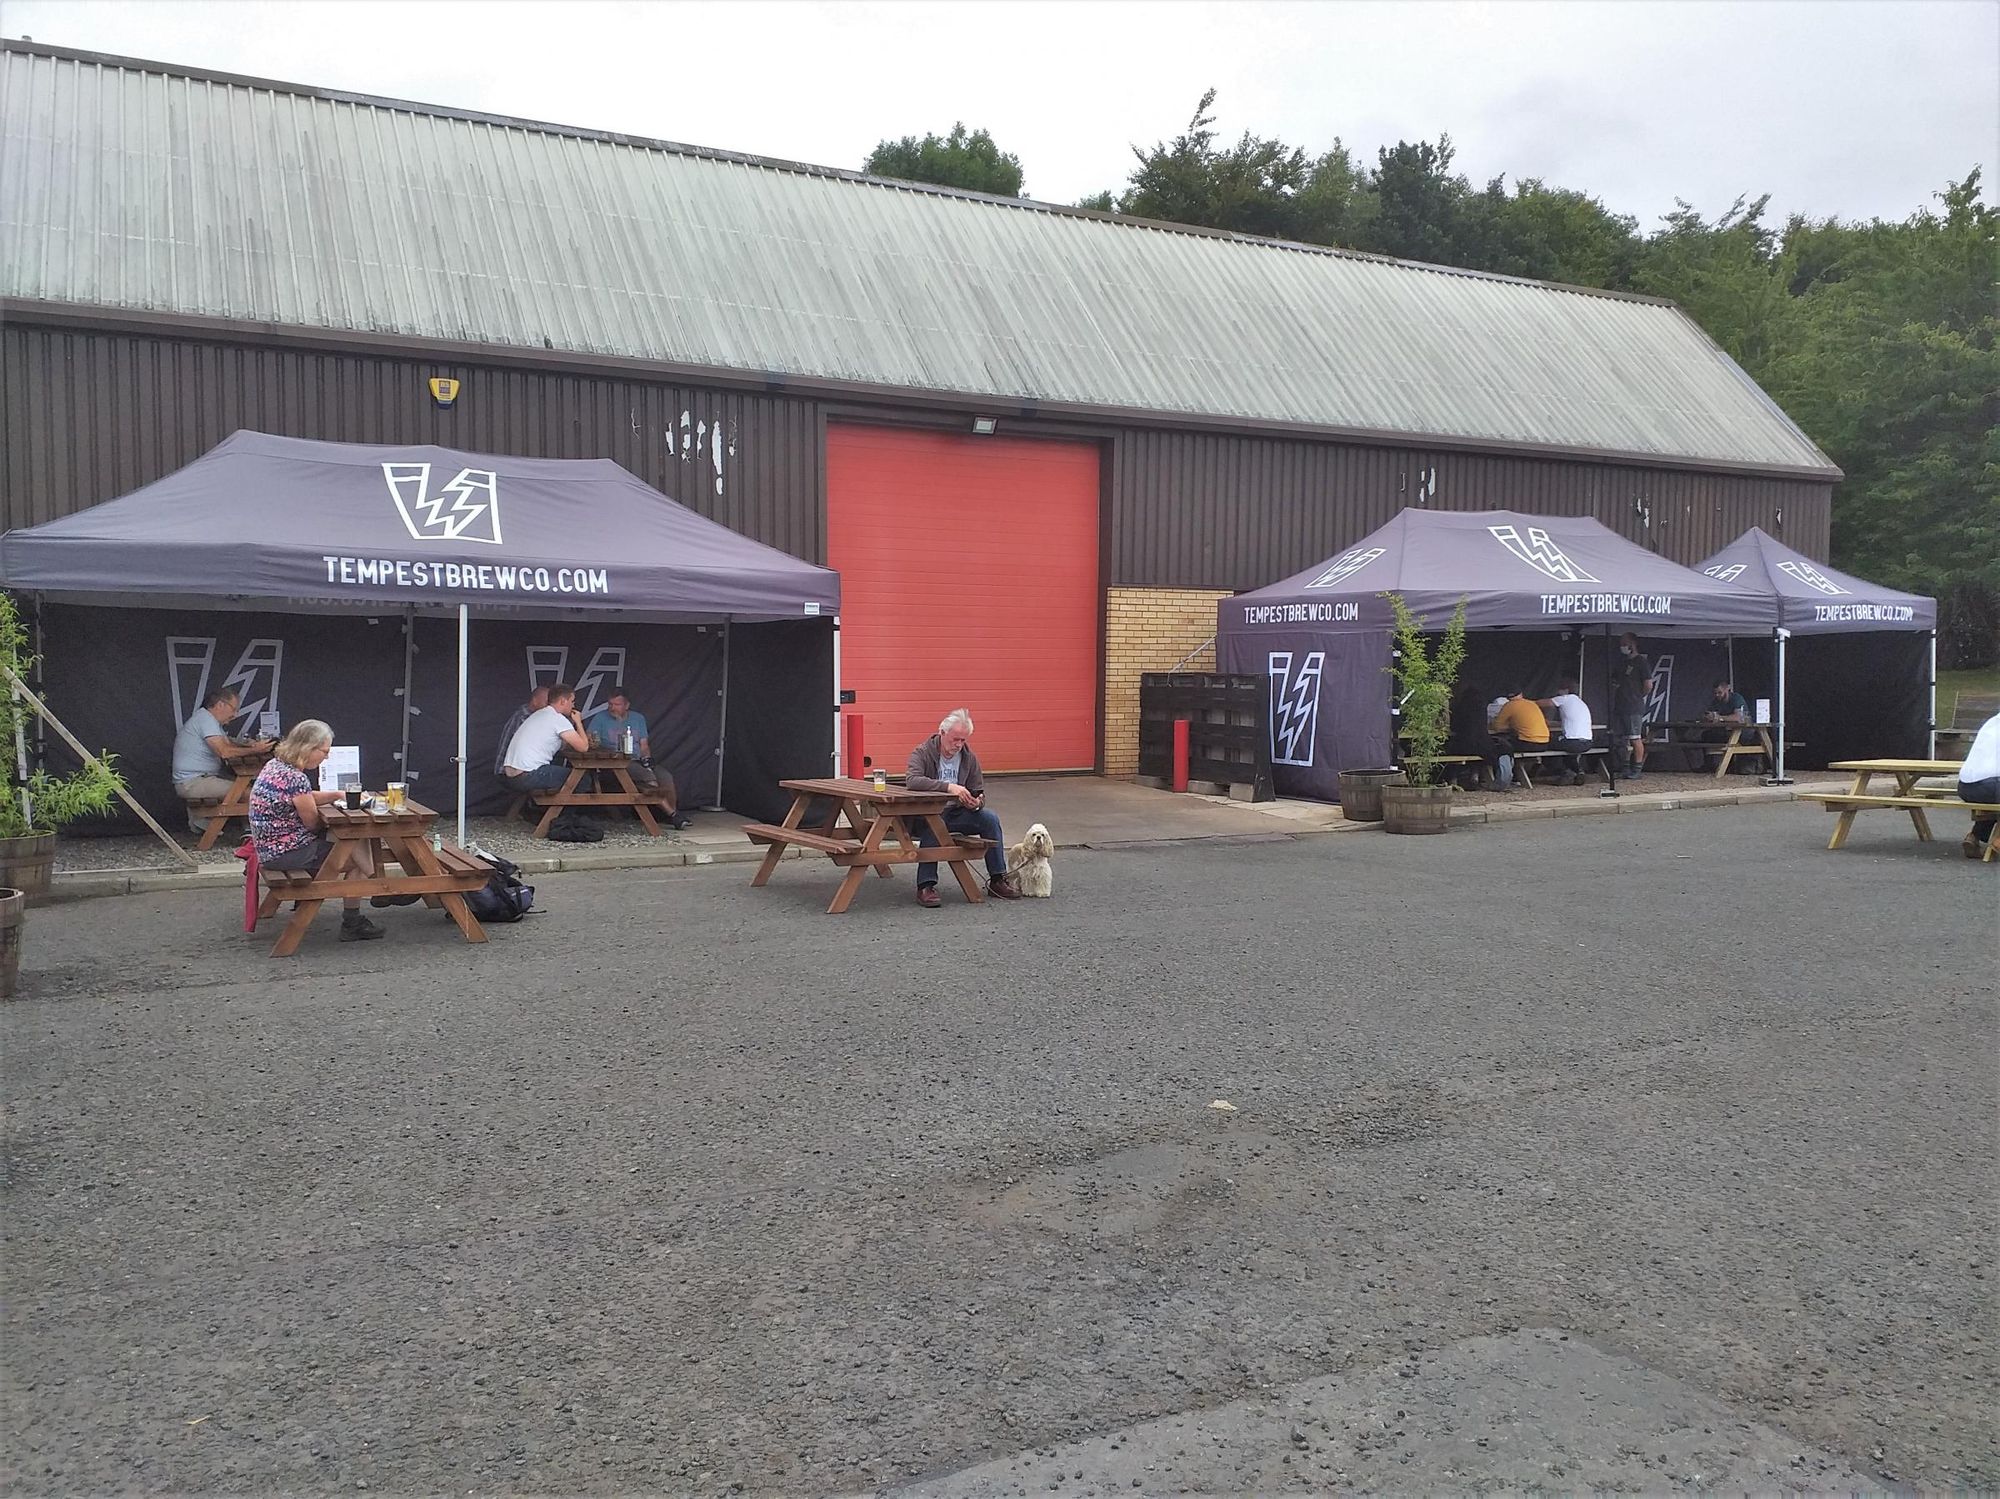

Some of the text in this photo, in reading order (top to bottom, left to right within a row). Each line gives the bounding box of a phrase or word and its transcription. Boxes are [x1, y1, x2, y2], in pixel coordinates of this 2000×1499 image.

[323, 556, 609, 593] TEMPESTBREWCO.COM
[1244, 602, 1359, 624] TEMPESTBREWCO.COM
[1540, 594, 1671, 614] TEMPESTBREWCO.COM
[1814, 604, 1913, 621] TEMPESTBREWCO.COM
